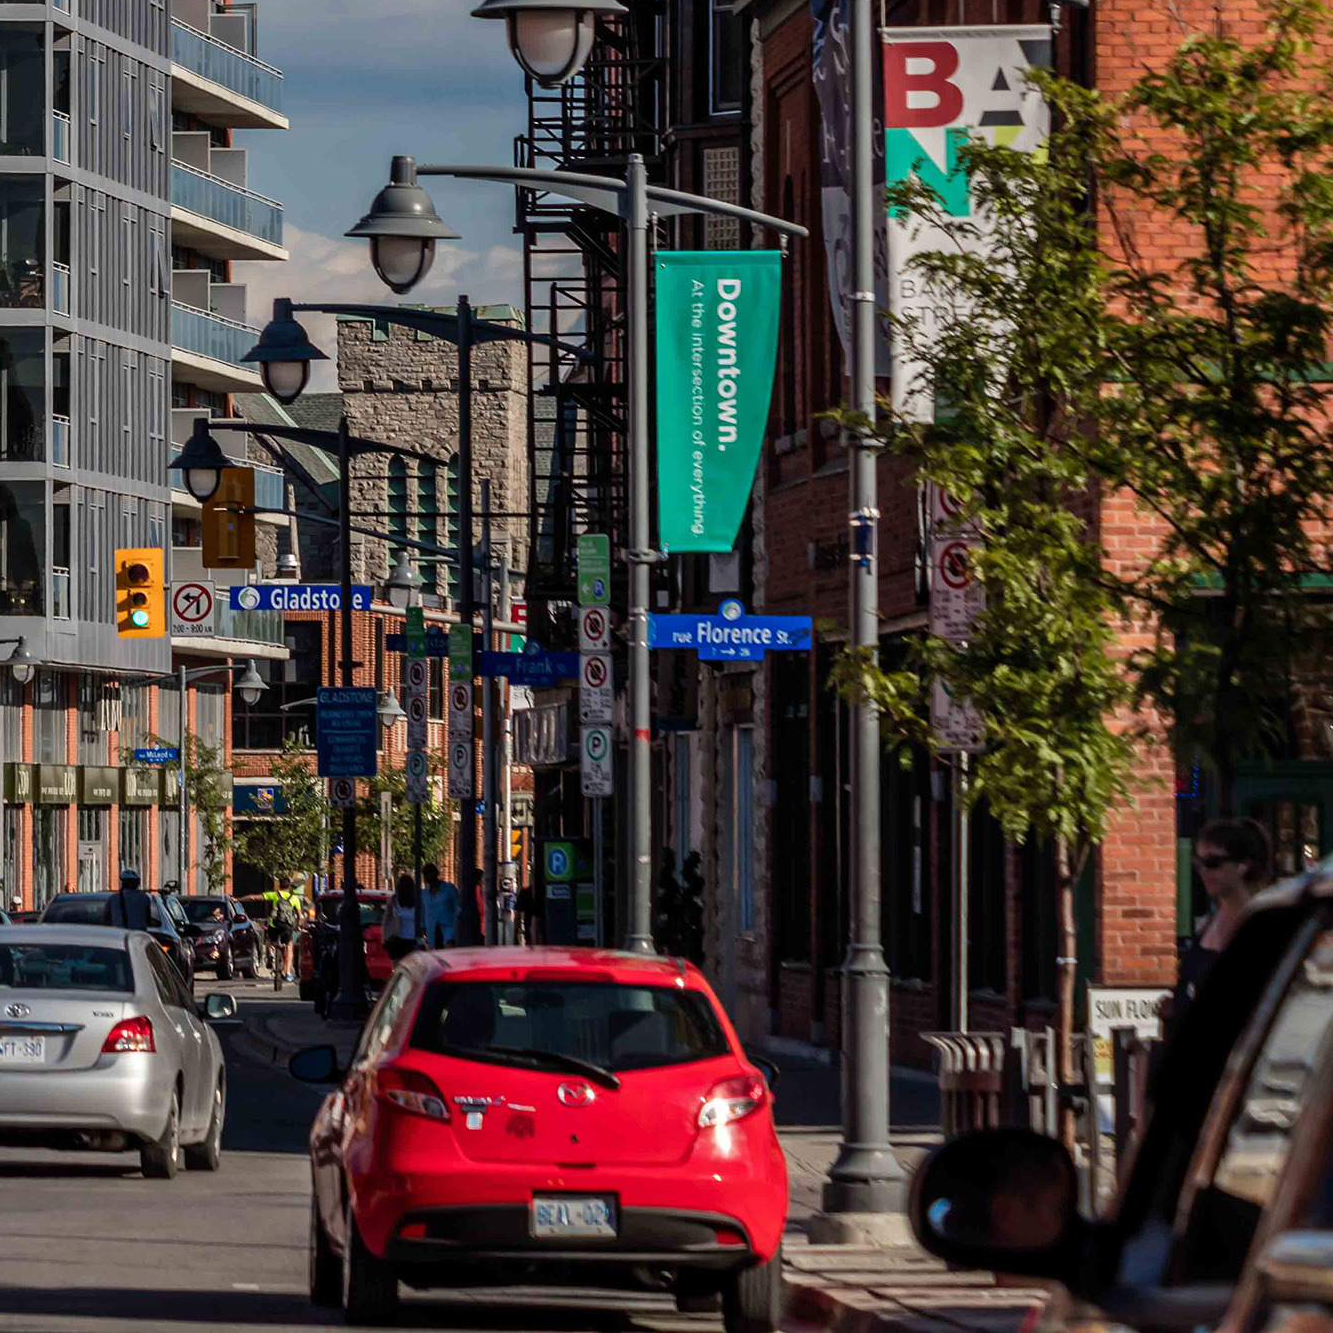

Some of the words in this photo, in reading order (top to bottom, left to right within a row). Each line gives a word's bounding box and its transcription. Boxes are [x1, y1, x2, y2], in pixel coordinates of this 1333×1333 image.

[691, 279, 706, 298] At
[691, 302, 705, 328] the
[717, 278, 742, 451] Downtown.
[691, 333, 705, 426] intersection
[691, 430, 706, 447] of
[270, 587, 363, 610] Gladstoe
[672, 631, 692, 643] rue
[697, 621, 771, 644] Florence
[515, 658, 553, 674] Frank
[319, 691, 374, 704] GLADSTONE
[146, 750, 168, 759] McLeod
[1095, 999, 1122, 1020] SUN
